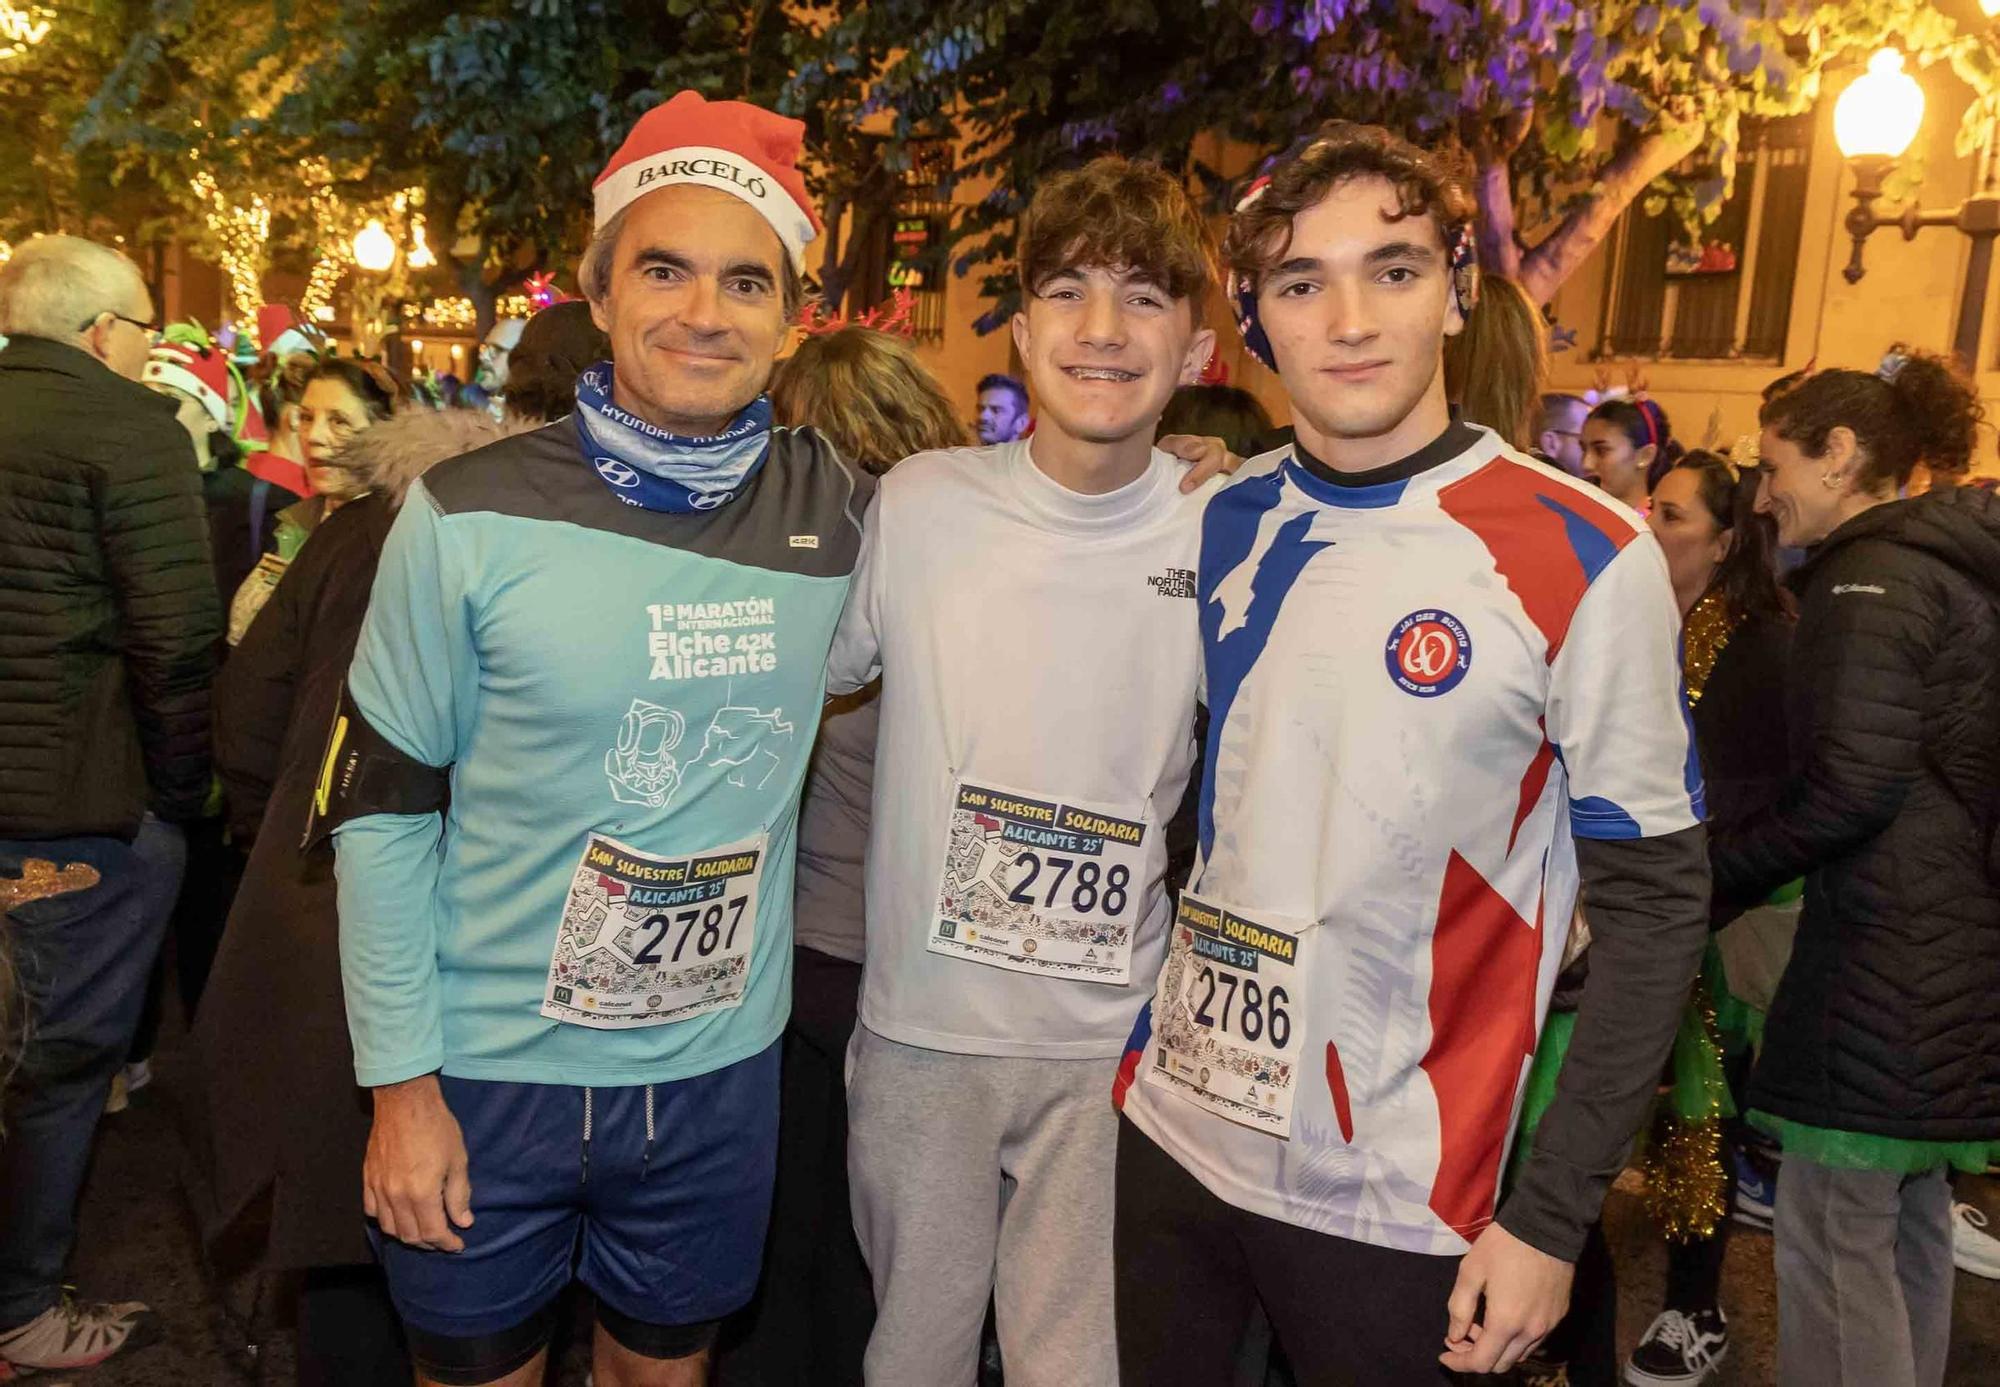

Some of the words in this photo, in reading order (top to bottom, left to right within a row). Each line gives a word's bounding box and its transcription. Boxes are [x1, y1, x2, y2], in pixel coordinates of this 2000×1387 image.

[634, 159, 766, 198] BARCELÓ
[601, 404, 673, 441] HYUNDAI
[1147, 576, 1185, 589] NORTH
[1166, 568, 1186, 579] THE
[1158, 587, 1185, 598] FACE
[676, 596, 774, 620] MARATÓN
[677, 615, 775, 630] INTERNACIONAL
[649, 631, 731, 657] Elche
[734, 632, 776, 651] 42K
[1440, 616, 1468, 647] BOXING
[648, 650, 777, 680] Alicante
[960, 790, 987, 806] SAN
[990, 798, 1054, 822] SILVESTRE
[1065, 811, 1141, 842] SOLIDARIA
[1004, 824, 1077, 850] ALICANTE
[589, 847, 613, 866] SAN
[616, 859, 684, 881] SILVESTRE
[694, 855, 753, 879] SOLIDARIA
[630, 886, 703, 904] ALICANTE
[1008, 852, 1130, 916] 2788
[633, 895, 748, 964] 2787
[1225, 919, 1293, 959] SOLIDARIA
[1194, 966, 1290, 1049] 2786
